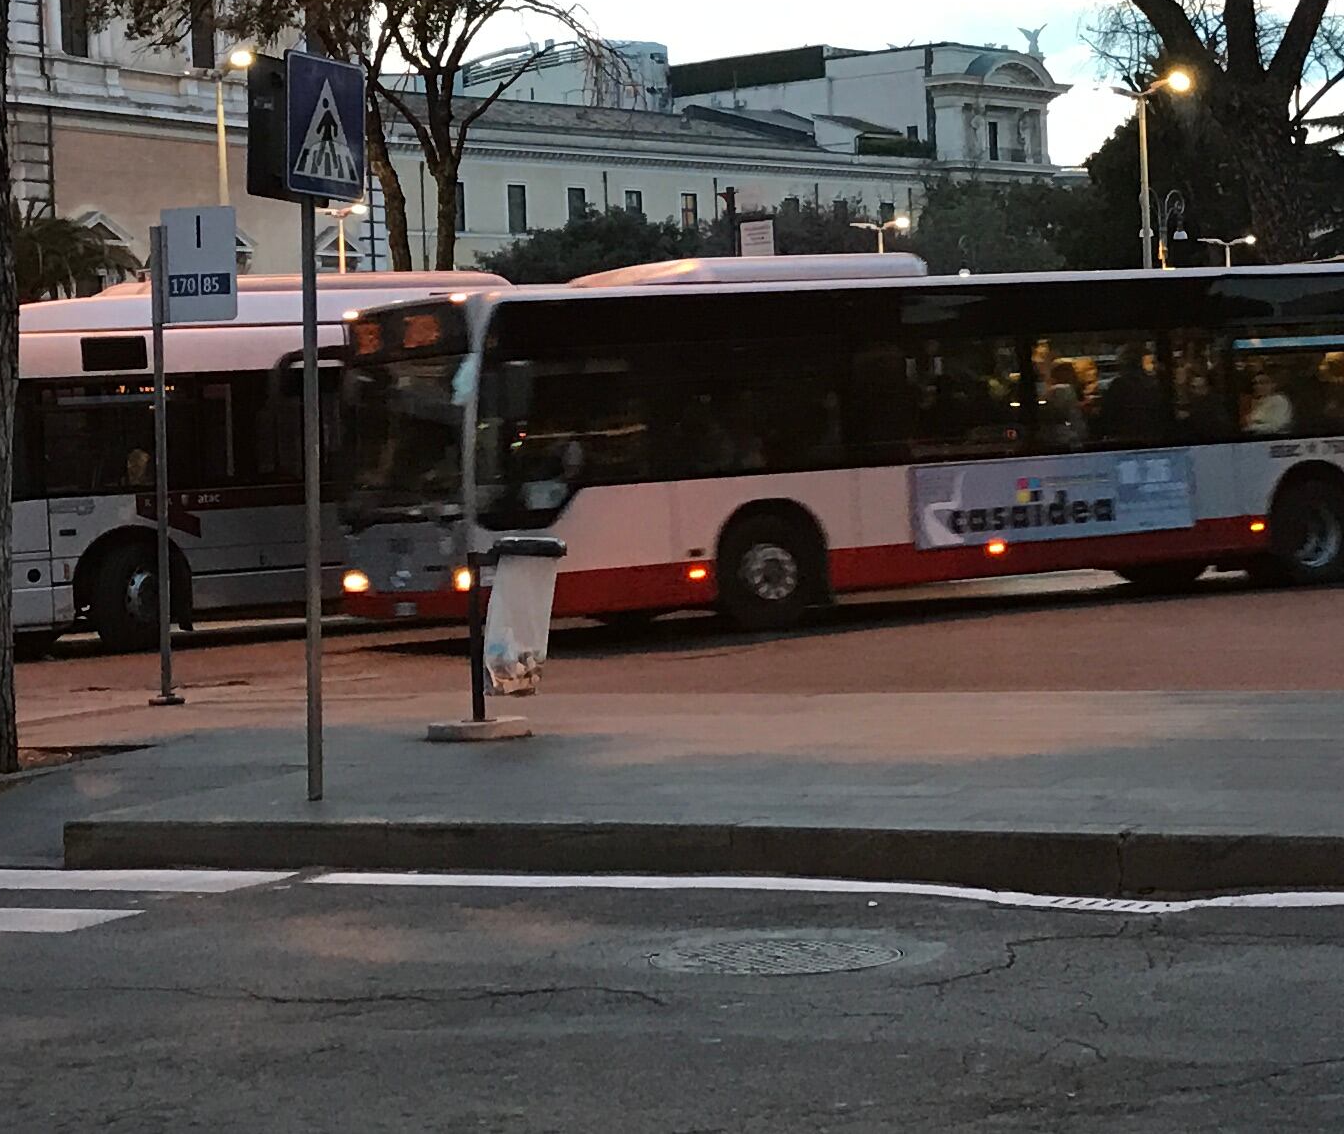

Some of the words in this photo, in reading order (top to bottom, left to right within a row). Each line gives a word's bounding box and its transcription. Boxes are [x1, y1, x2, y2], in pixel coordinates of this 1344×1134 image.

[171, 276, 196, 294] 170
[203, 276, 220, 293] 85
[197, 493, 222, 505] atac
[949, 489, 1117, 534] casaidea
